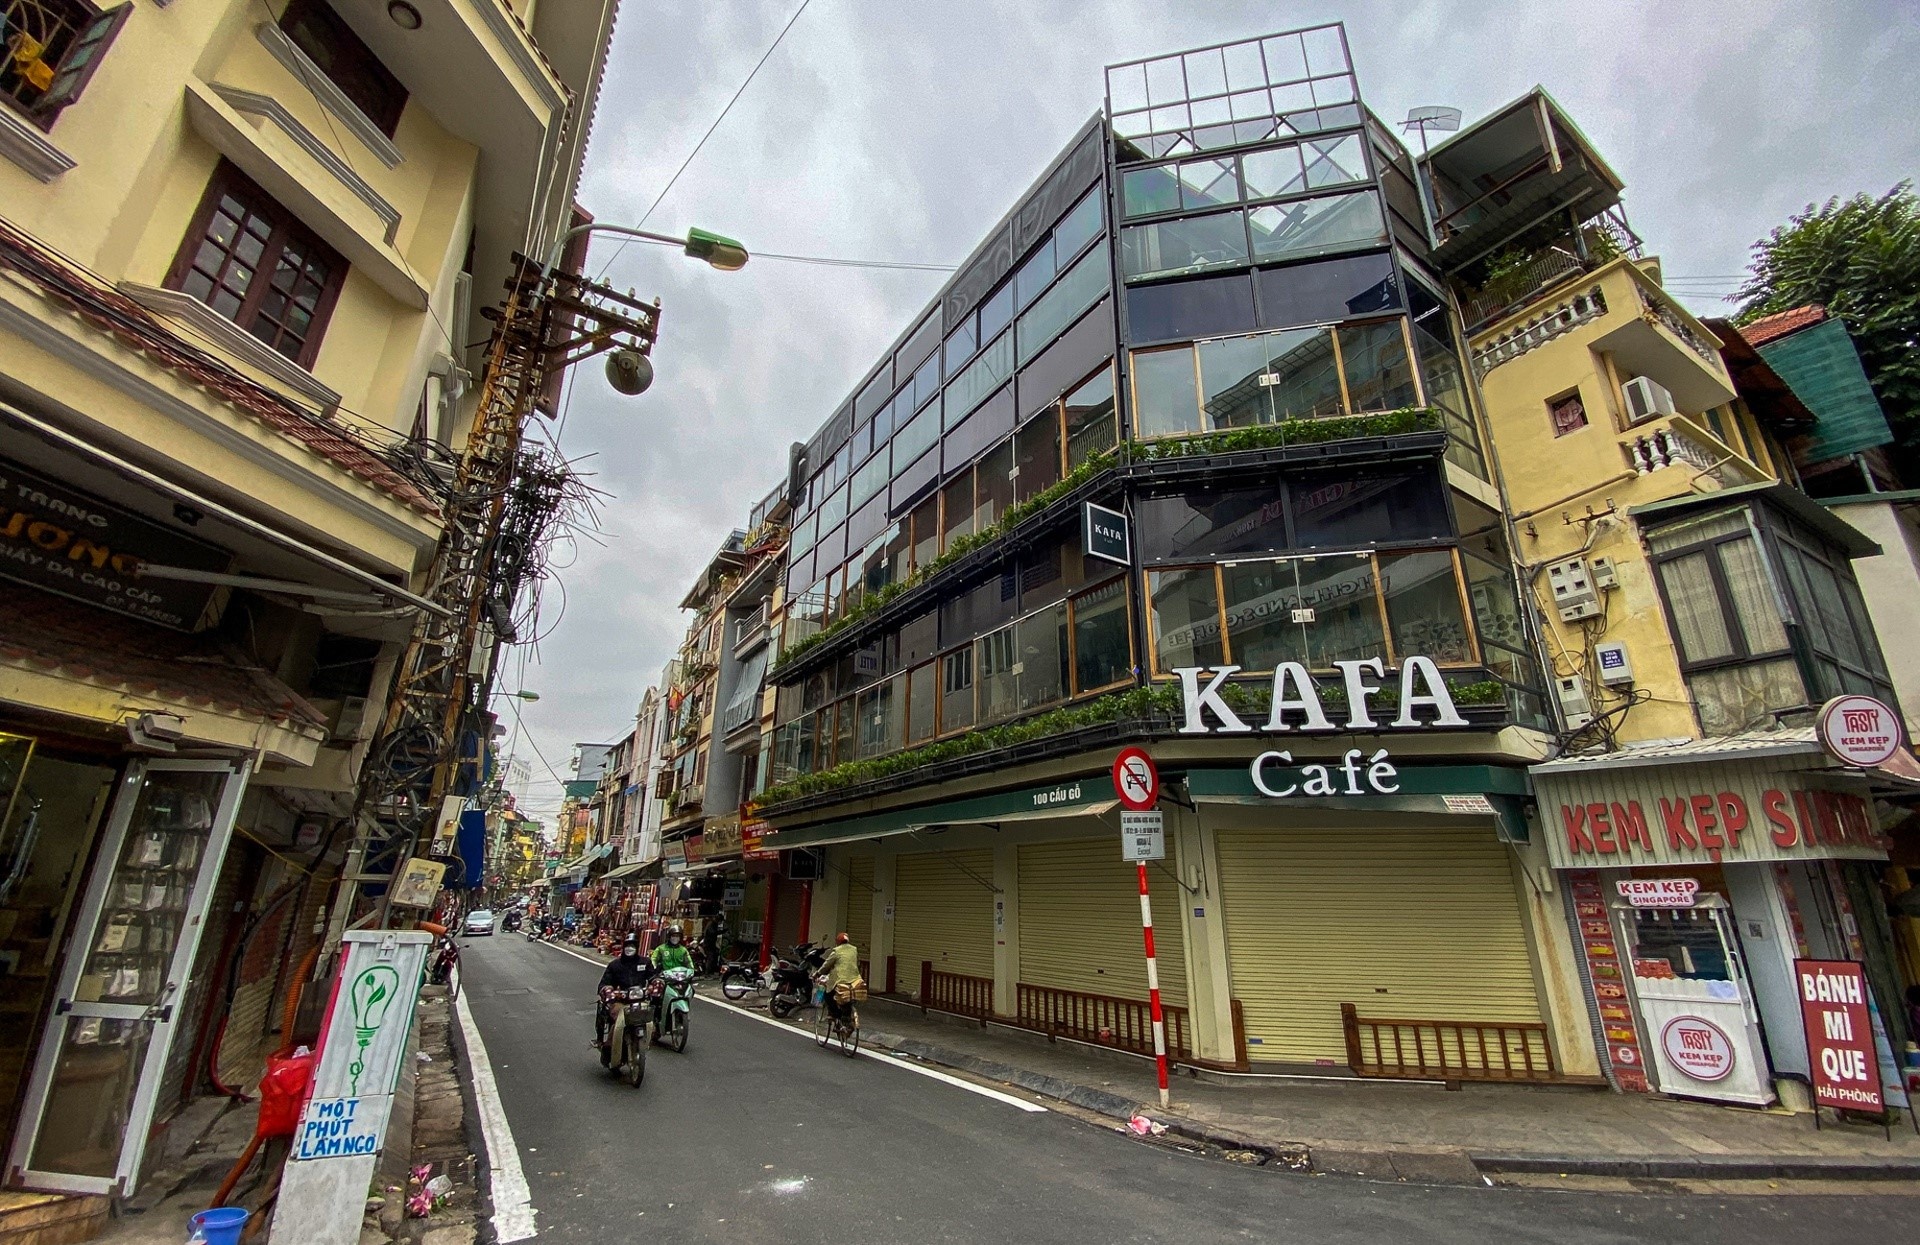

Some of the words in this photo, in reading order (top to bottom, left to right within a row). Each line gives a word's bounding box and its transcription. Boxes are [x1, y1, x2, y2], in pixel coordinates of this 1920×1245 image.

[1095, 523, 1122, 541] KAFA
[1171, 655, 1470, 734] KAFA
[1842, 709, 1880, 733] TASTY
[1841, 737, 1866, 746] KEM
[1250, 748, 1400, 798] Café
[1032, 793, 1048, 806] 100
[1561, 801, 1653, 855] KEM
[1659, 792, 1748, 863] KẸP
[1620, 883, 1658, 894] KEM
[1661, 881, 1695, 896] KẸP
[1633, 896, 1690, 904] SINGAPORE
[1802, 968, 1863, 1005] BÁNH
[1823, 1005, 1854, 1041] MÌ
[1678, 1028, 1714, 1051] TASTY
[1679, 1052, 1702, 1061] KEM
[1821, 1047, 1868, 1082] QUE
[1818, 1083, 1837, 1099] HẢI
[1839, 1087, 1879, 1104] PHÒNG
[305, 1116, 354, 1138] PHÚT
